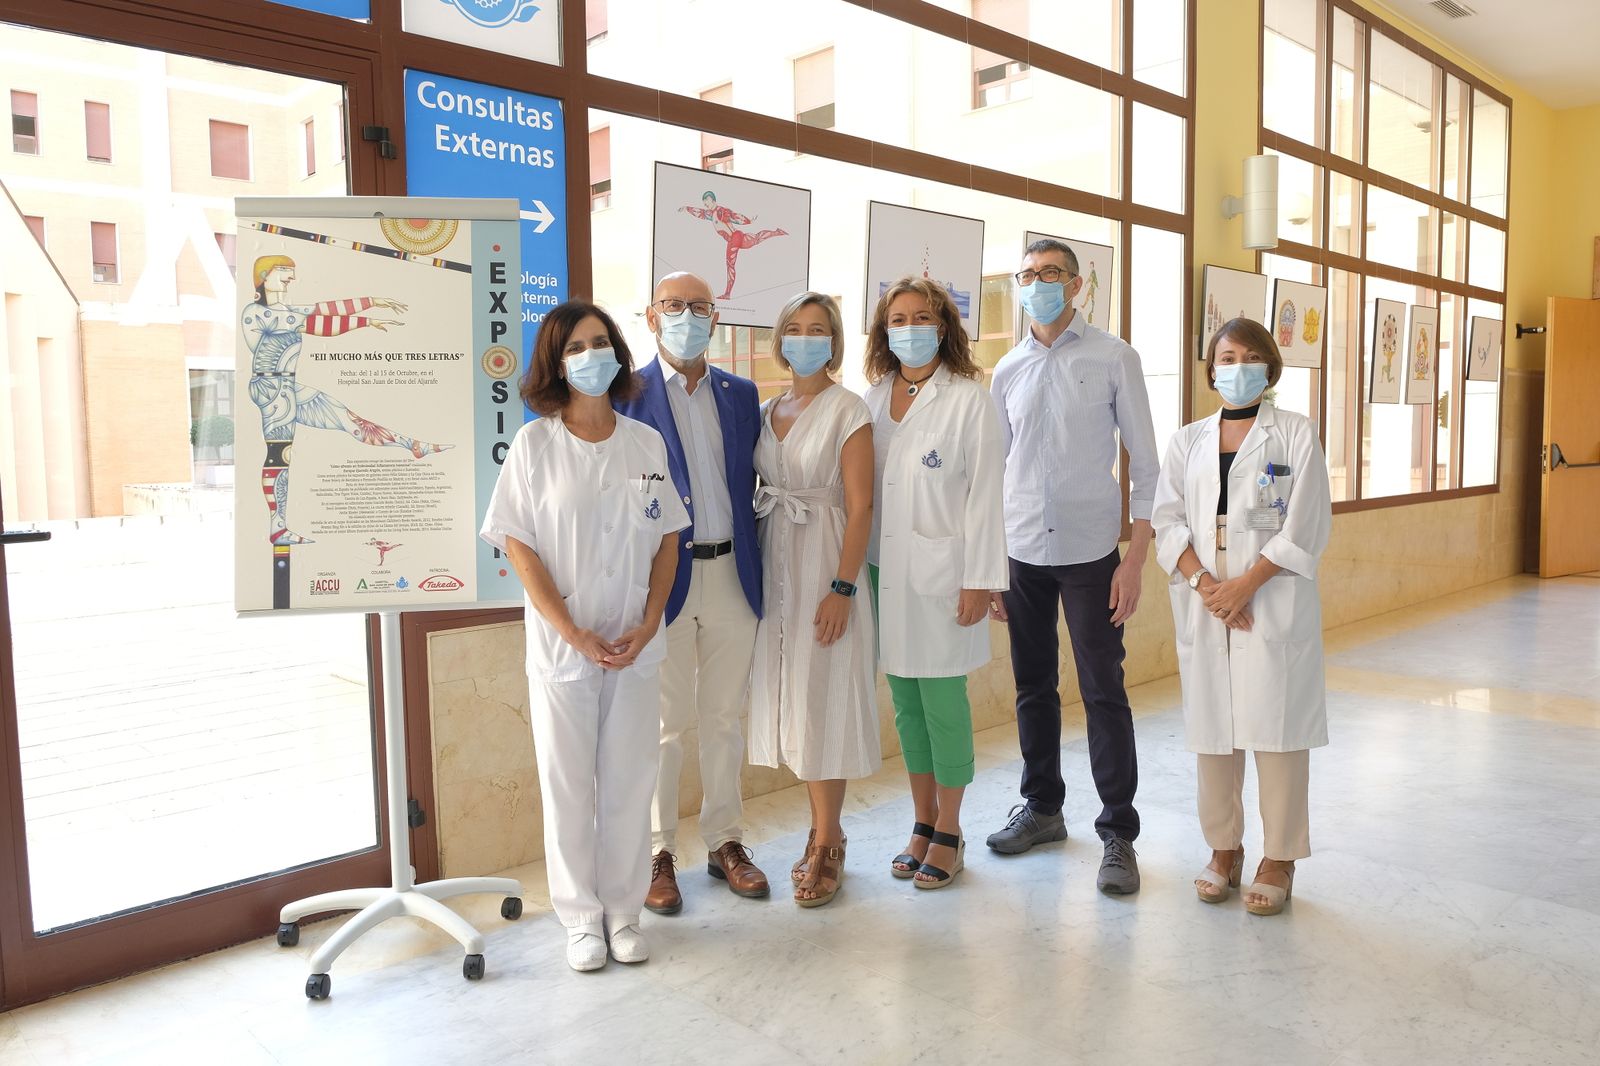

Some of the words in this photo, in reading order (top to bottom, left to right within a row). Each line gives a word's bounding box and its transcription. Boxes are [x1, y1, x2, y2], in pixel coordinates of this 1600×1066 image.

[417, 81, 554, 131] Consultas
[435, 123, 556, 169] Externas
[329, 352, 362, 361] MUCHO
[364, 350, 383, 361] MÁS
[385, 352, 403, 363] QUE
[405, 352, 427, 361] TRES
[428, 352, 465, 361] LETRAS”
[396, 369, 419, 377] Octubre,
[337, 378, 360, 386] Hospital
[417, 378, 438, 386] Aljarafe
[315, 579, 340, 591] ACCU
[426, 580, 458, 589] Takeda
